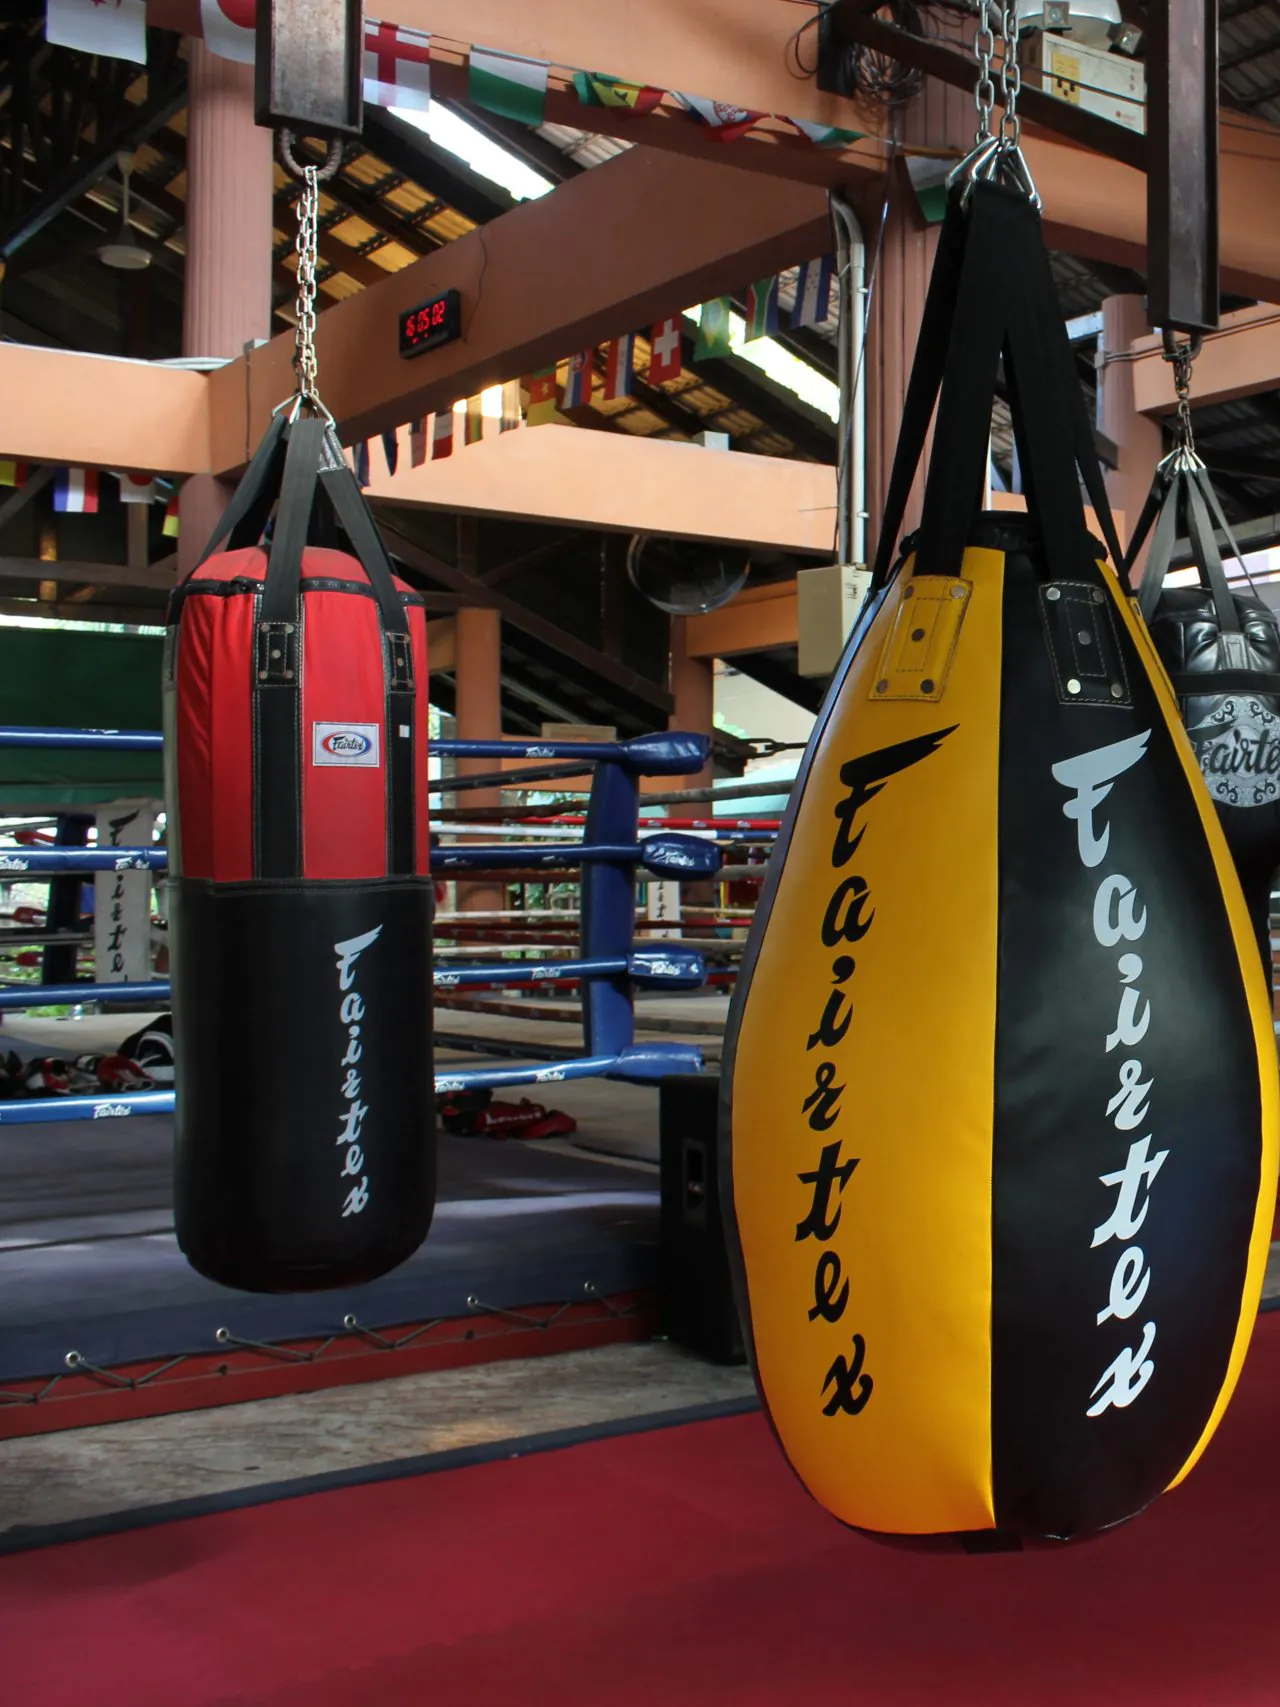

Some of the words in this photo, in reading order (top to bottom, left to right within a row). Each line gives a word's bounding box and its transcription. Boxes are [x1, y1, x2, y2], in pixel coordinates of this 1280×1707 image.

[108, 809, 141, 983] Firte
[334, 923, 384, 1218] Fairtex
[795, 723, 960, 1417] Fairtex
[1051, 728, 1170, 1417] Fairtex
